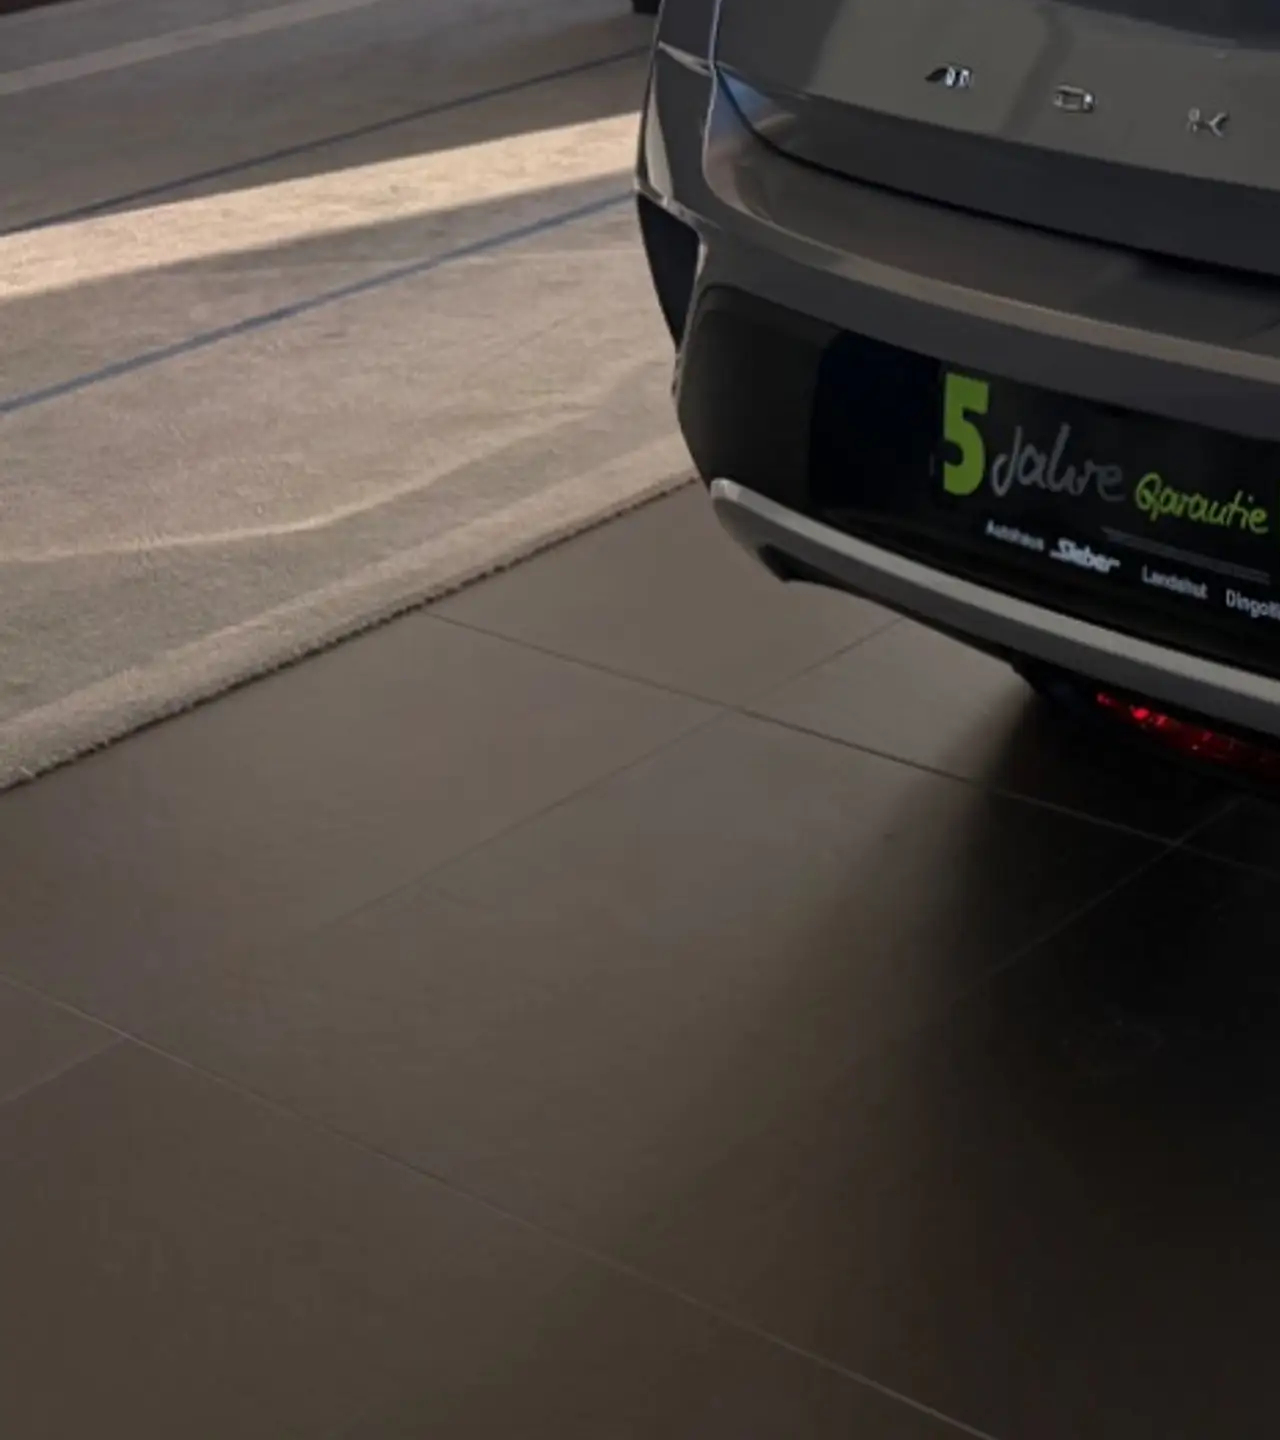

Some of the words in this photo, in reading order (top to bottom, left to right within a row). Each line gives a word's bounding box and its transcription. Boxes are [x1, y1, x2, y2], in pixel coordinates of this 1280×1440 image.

[942, 372, 990, 496] 5
[990, 422, 1126, 503] Jahre
[1134, 471, 1270, 534] Garantie
